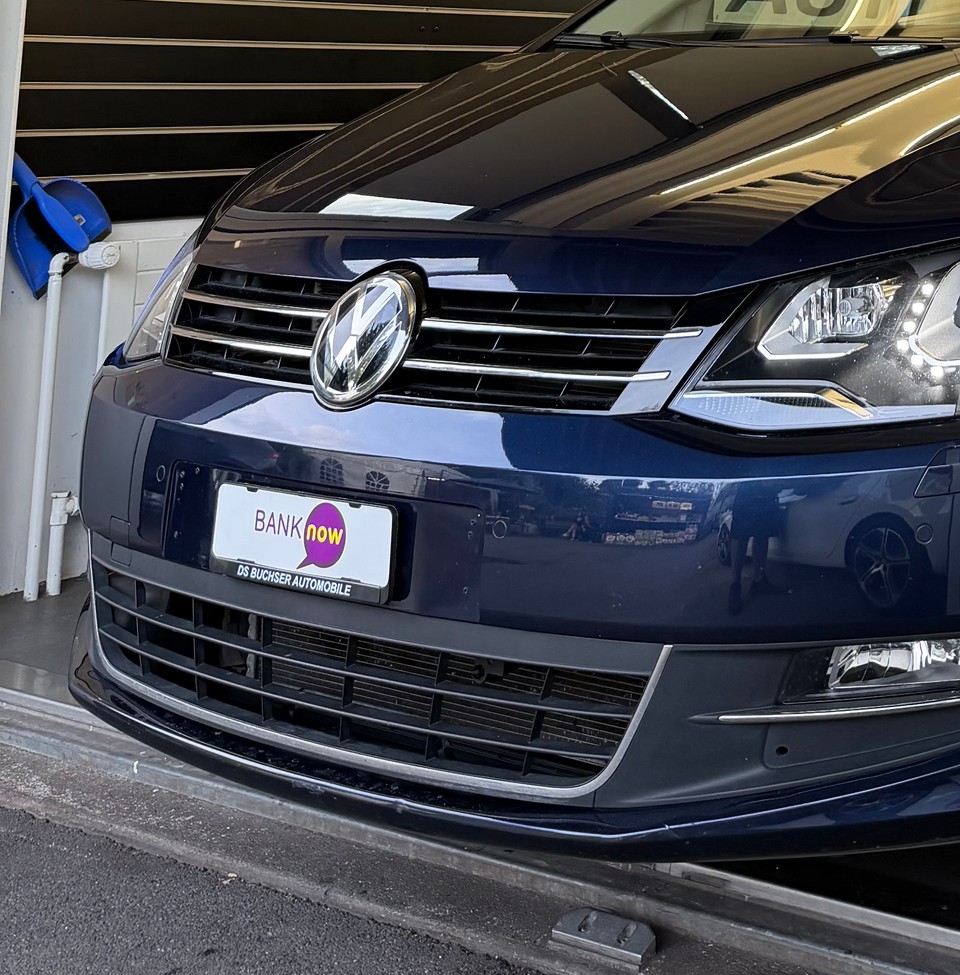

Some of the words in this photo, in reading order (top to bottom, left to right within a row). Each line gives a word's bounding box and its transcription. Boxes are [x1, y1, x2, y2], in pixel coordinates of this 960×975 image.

[254, 509, 303, 538] BANK
[306, 524, 343, 545] now
[237, 564, 249, 577] DS
[250, 568, 291, 585] BUCHSER
[292, 576, 351, 596] AUTOMOBILE
